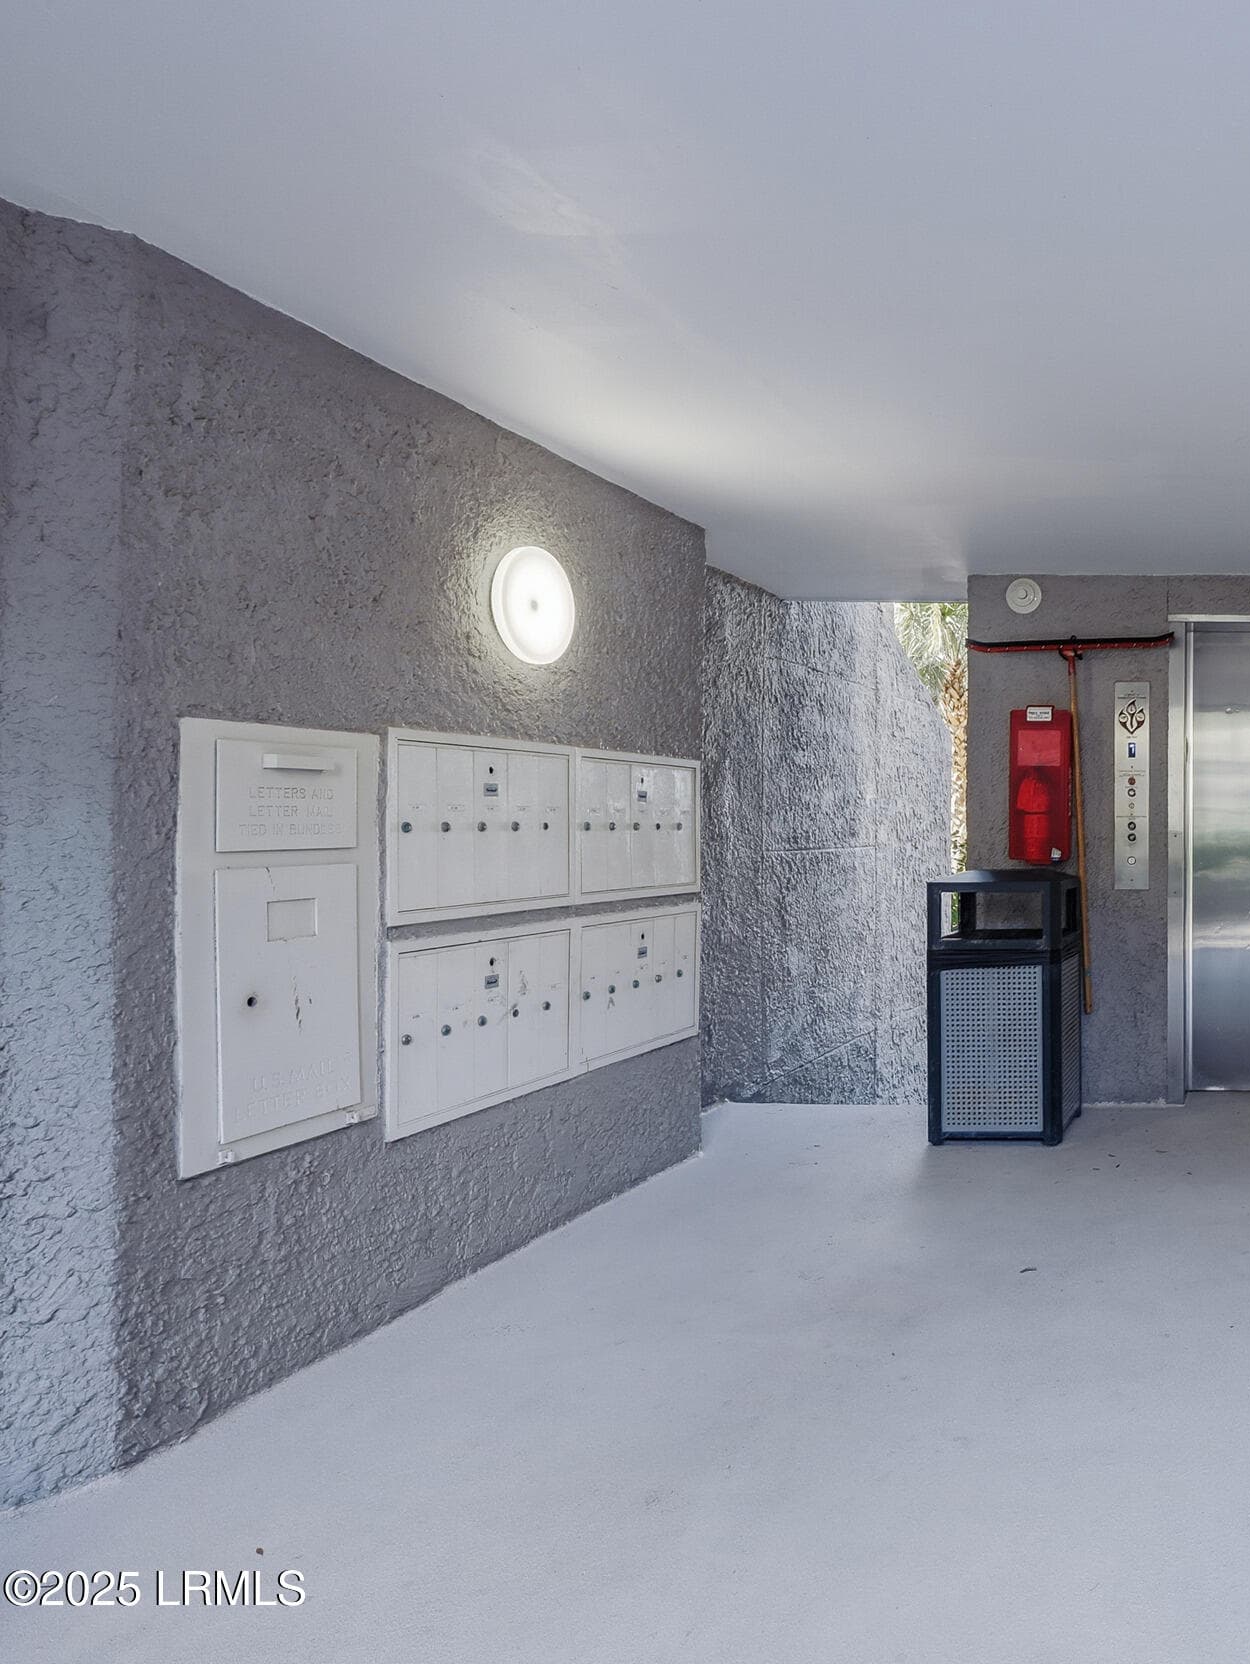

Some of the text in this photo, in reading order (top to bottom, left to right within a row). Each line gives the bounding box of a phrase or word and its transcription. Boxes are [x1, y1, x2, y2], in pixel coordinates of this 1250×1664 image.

[248, 785, 334, 800] LETTERS AND
[248, 804, 334, 818] LETTER MAIL
[239, 823, 267, 837] TIED
[272, 823, 284, 836] IN
